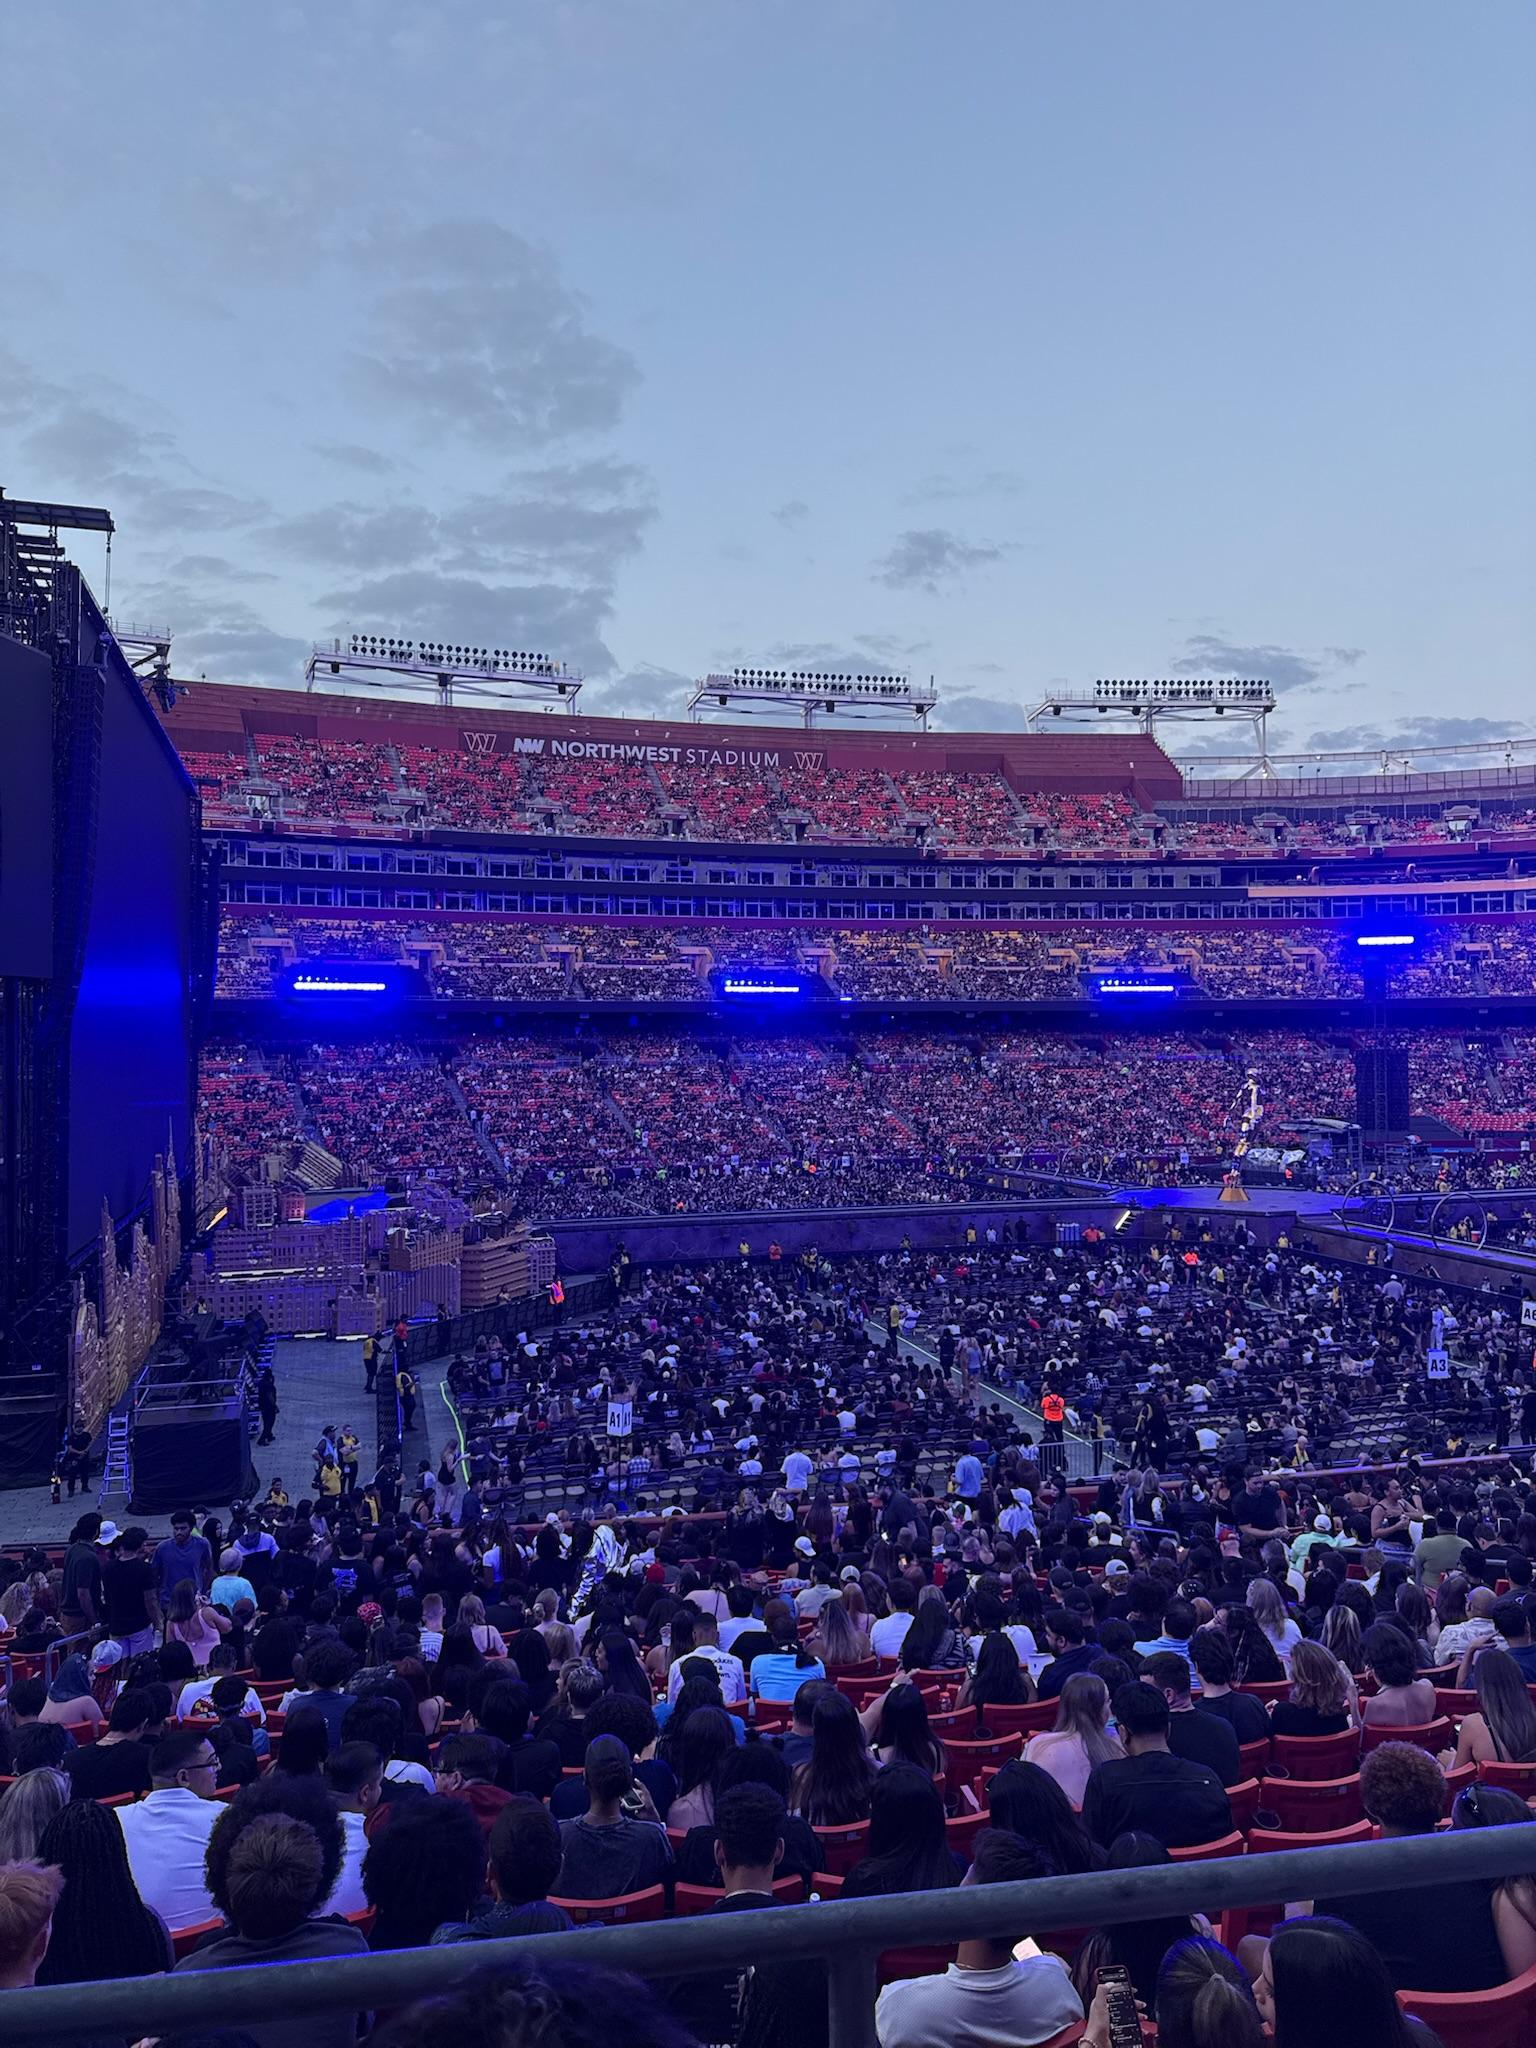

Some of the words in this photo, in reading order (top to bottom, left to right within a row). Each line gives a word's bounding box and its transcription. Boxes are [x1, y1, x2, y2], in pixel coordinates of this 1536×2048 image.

[551, 740, 682, 762] NORTHWEST
[686, 748, 780, 767] STADIUM
[1430, 1359, 1447, 1372] A3
[609, 1411, 621, 1428] A1
